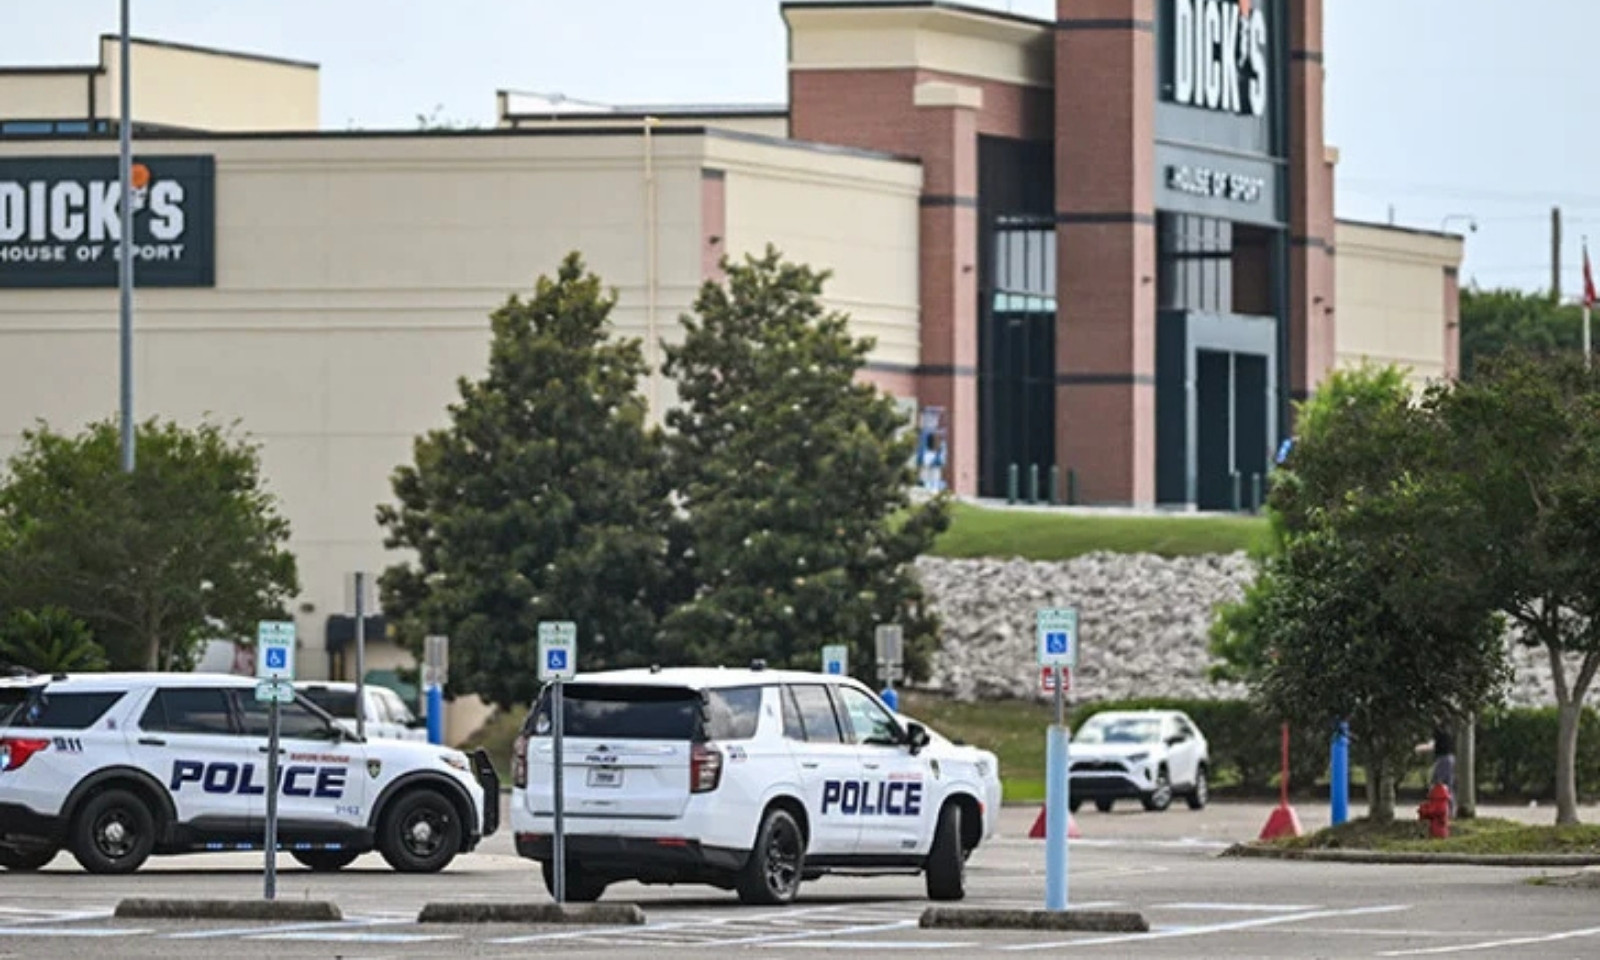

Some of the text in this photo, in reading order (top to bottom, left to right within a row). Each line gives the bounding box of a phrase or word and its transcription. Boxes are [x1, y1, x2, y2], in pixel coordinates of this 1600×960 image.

[1175, 0, 1267, 116] DICK'S
[0, 180, 184, 241] DICK'S
[76, 245, 104, 261] OF
[170, 760, 347, 799] POLCE
[821, 780, 922, 816] POLICE
